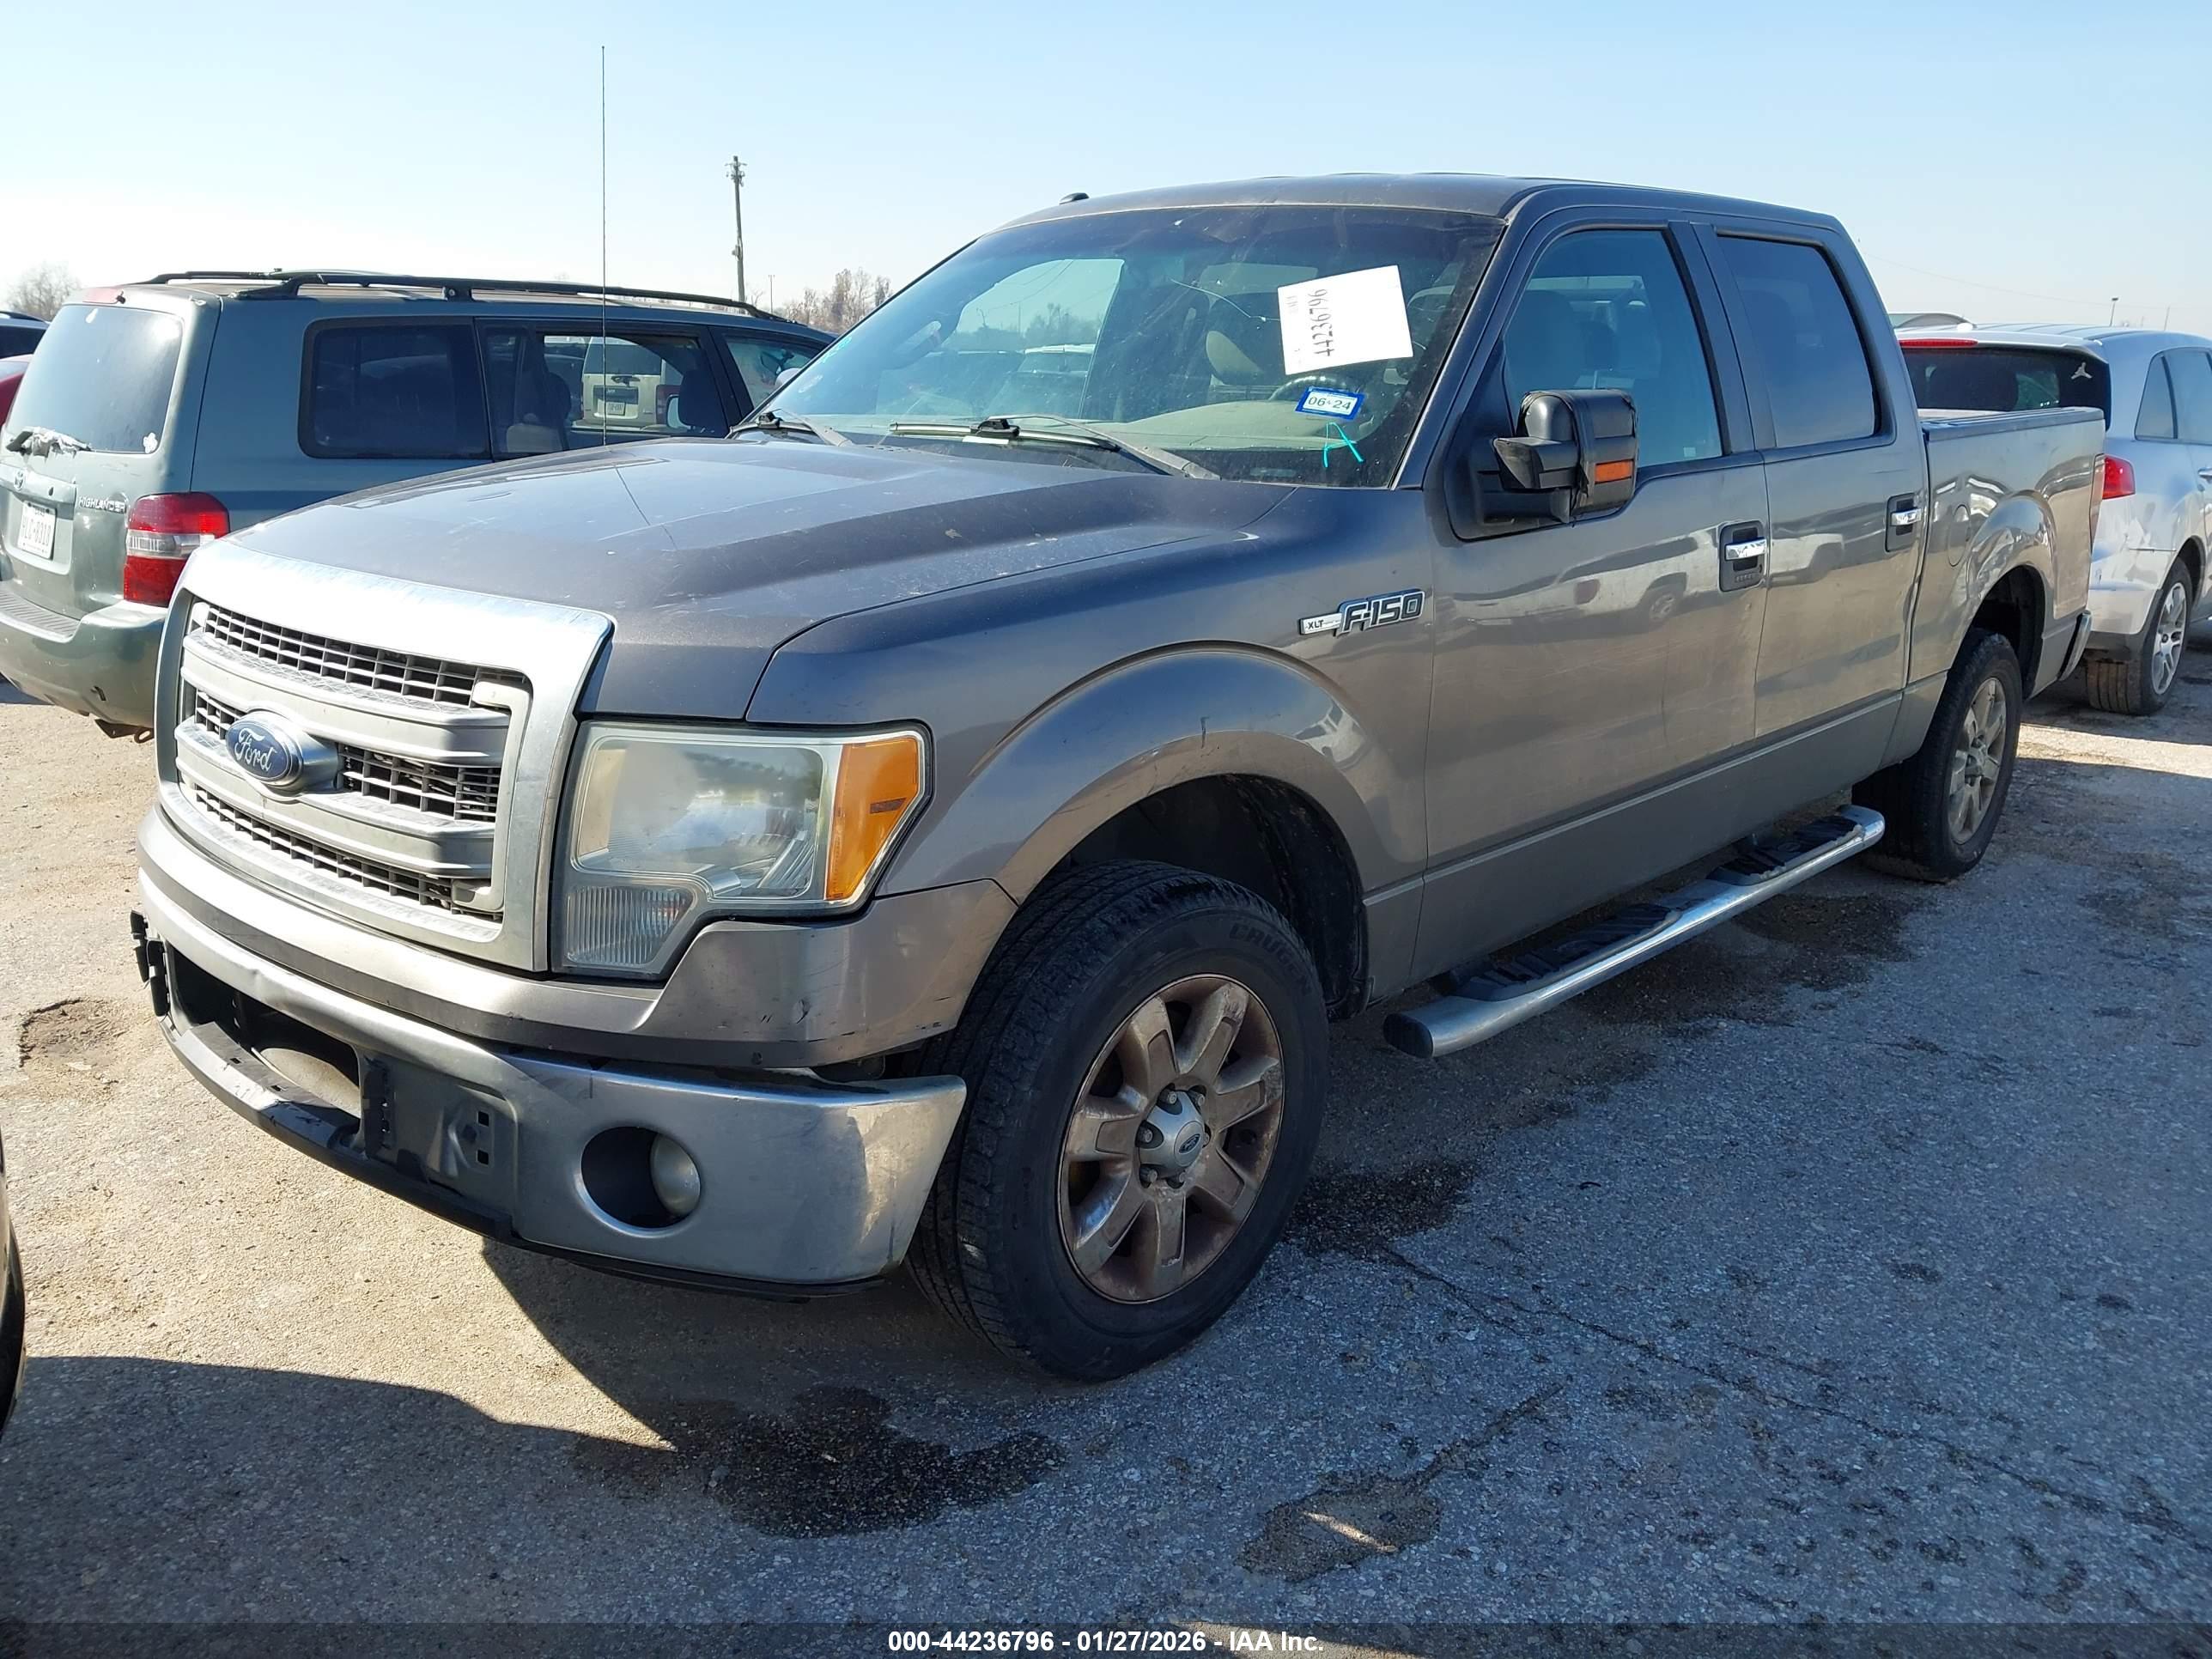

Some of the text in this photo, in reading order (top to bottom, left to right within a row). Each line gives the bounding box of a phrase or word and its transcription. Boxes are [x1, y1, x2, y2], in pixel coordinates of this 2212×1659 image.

[1308, 289, 1335, 357] 44236796
[1308, 397, 1352, 410] 06 24
[78, 495, 125, 513] HIGHLANDER
[1307, 619, 1325, 630] XLT
[1340, 591, 1425, 634] F-150
[234, 727, 278, 772] Ford
